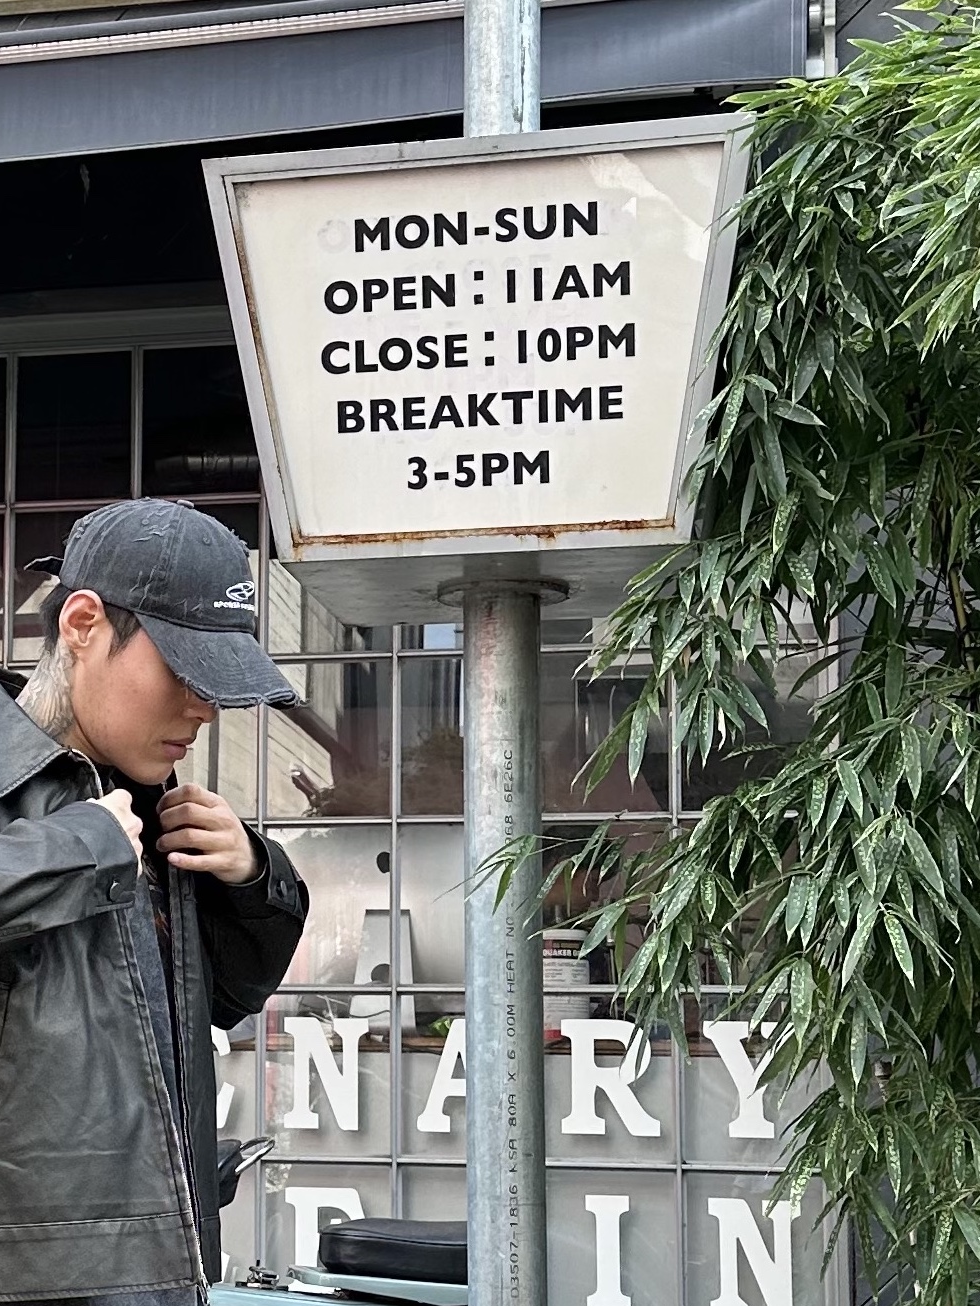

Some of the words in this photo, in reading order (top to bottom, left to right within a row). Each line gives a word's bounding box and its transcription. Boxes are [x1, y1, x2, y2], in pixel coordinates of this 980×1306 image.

[353, 201, 598, 252] MON-SUN
[337, 386, 624, 434] BREAKTIME
[407, 450, 551, 490] 3-5PM
[505, 948, 516, 993] HEAT
[507, 1093, 518, 1126] 80A
